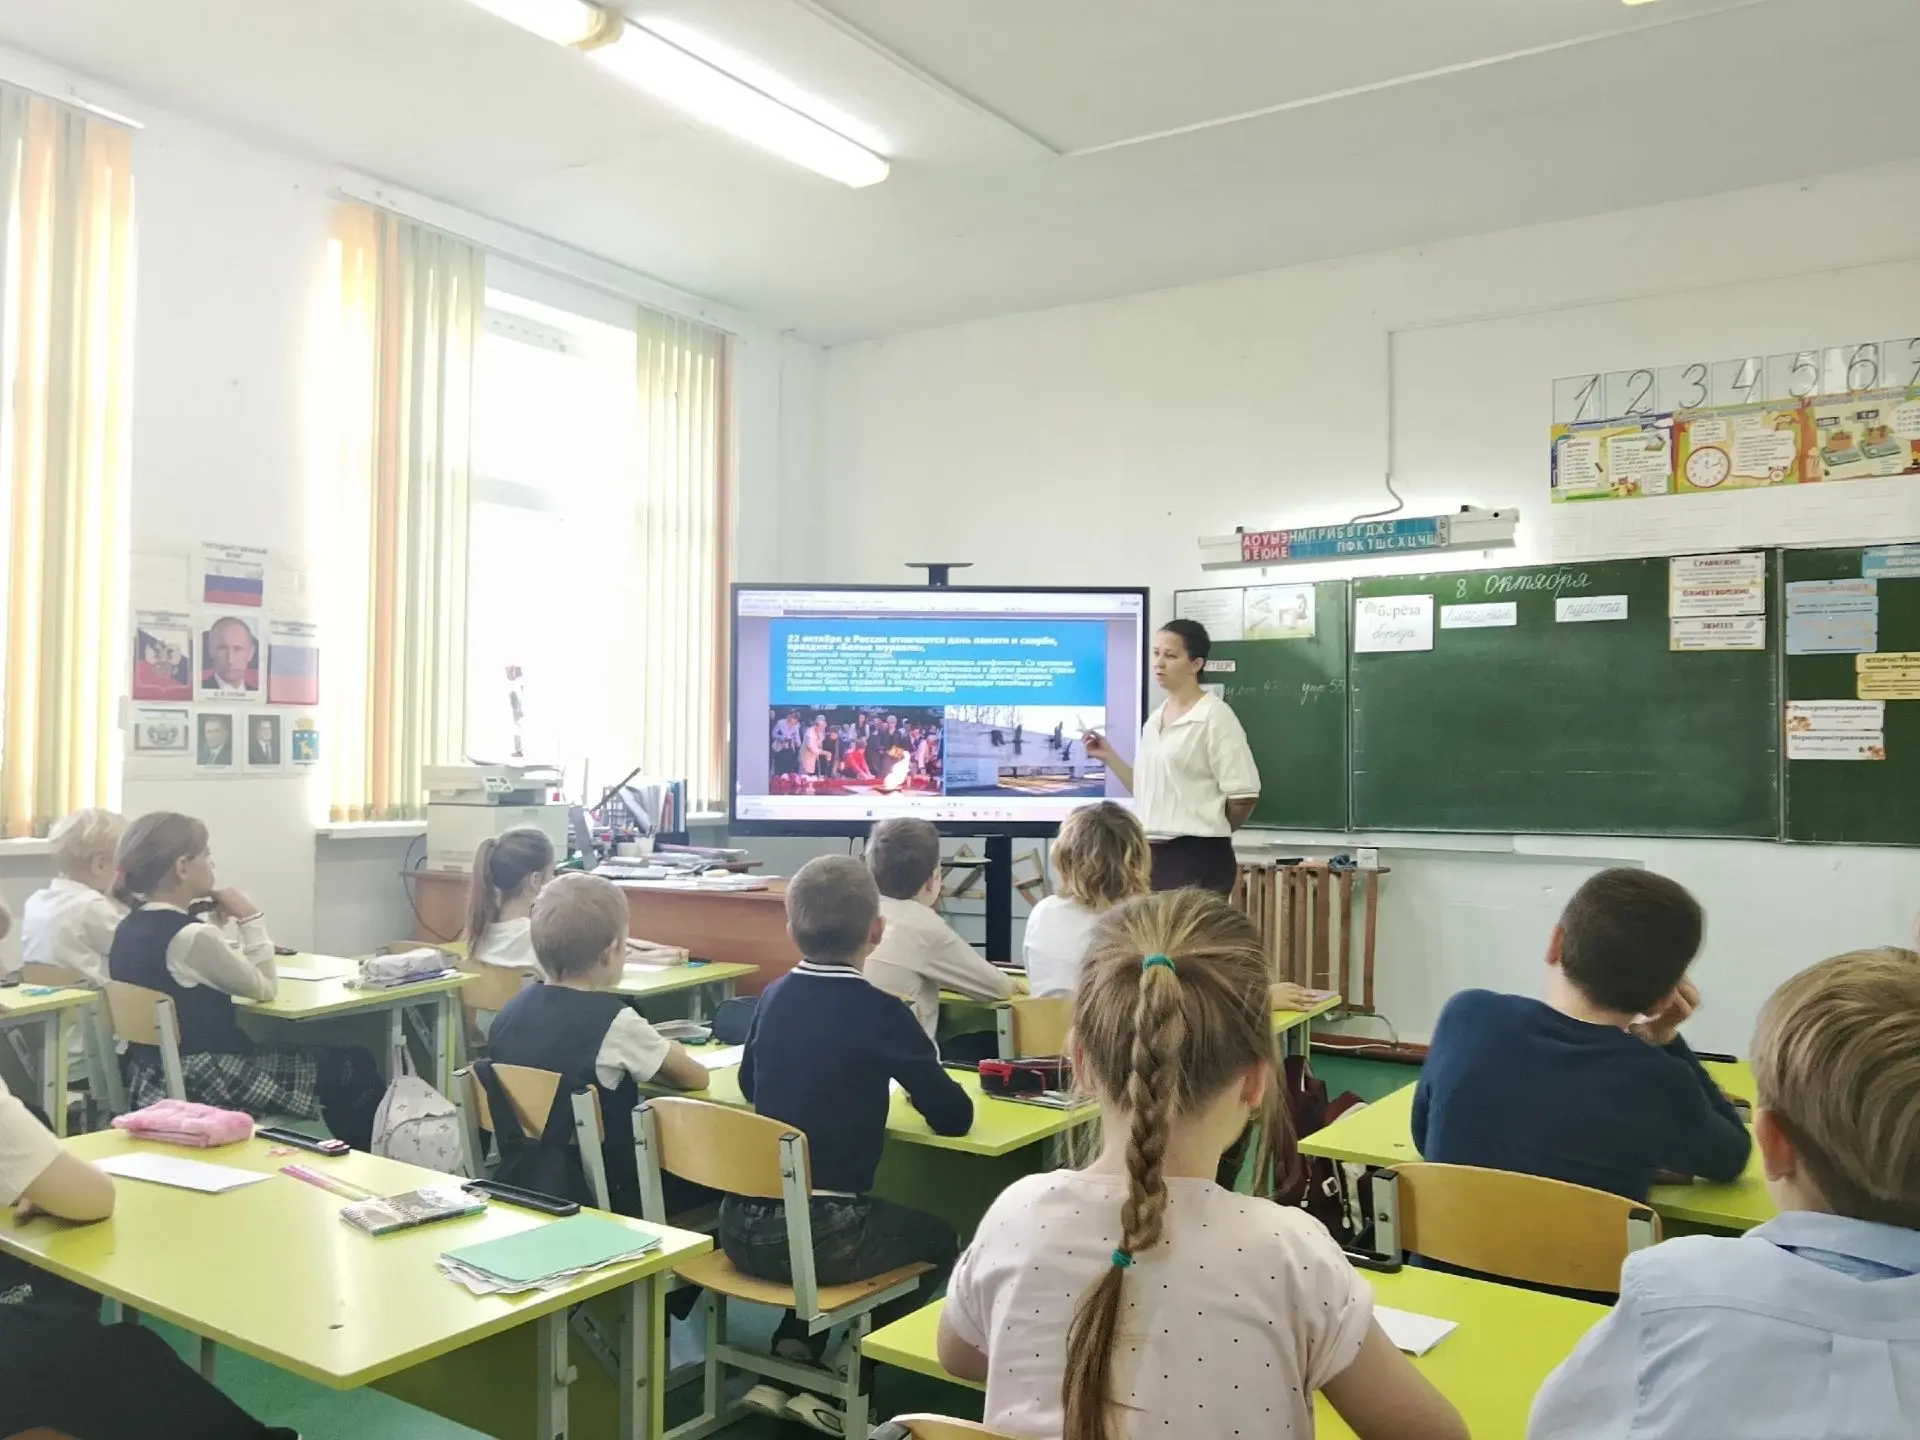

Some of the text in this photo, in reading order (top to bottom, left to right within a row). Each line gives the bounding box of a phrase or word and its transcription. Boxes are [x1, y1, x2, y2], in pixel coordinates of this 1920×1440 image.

[1574, 374, 1600, 422] 1
[1624, 369, 1654, 416] 2
[1678, 363, 1708, 409] 3
[1731, 358, 1763, 403] 4
[1788, 350, 1820, 398] 5
[1846, 342, 1879, 391] 6
[1455, 578, 1468, 599] 8
[787, 634, 800, 643] 22
